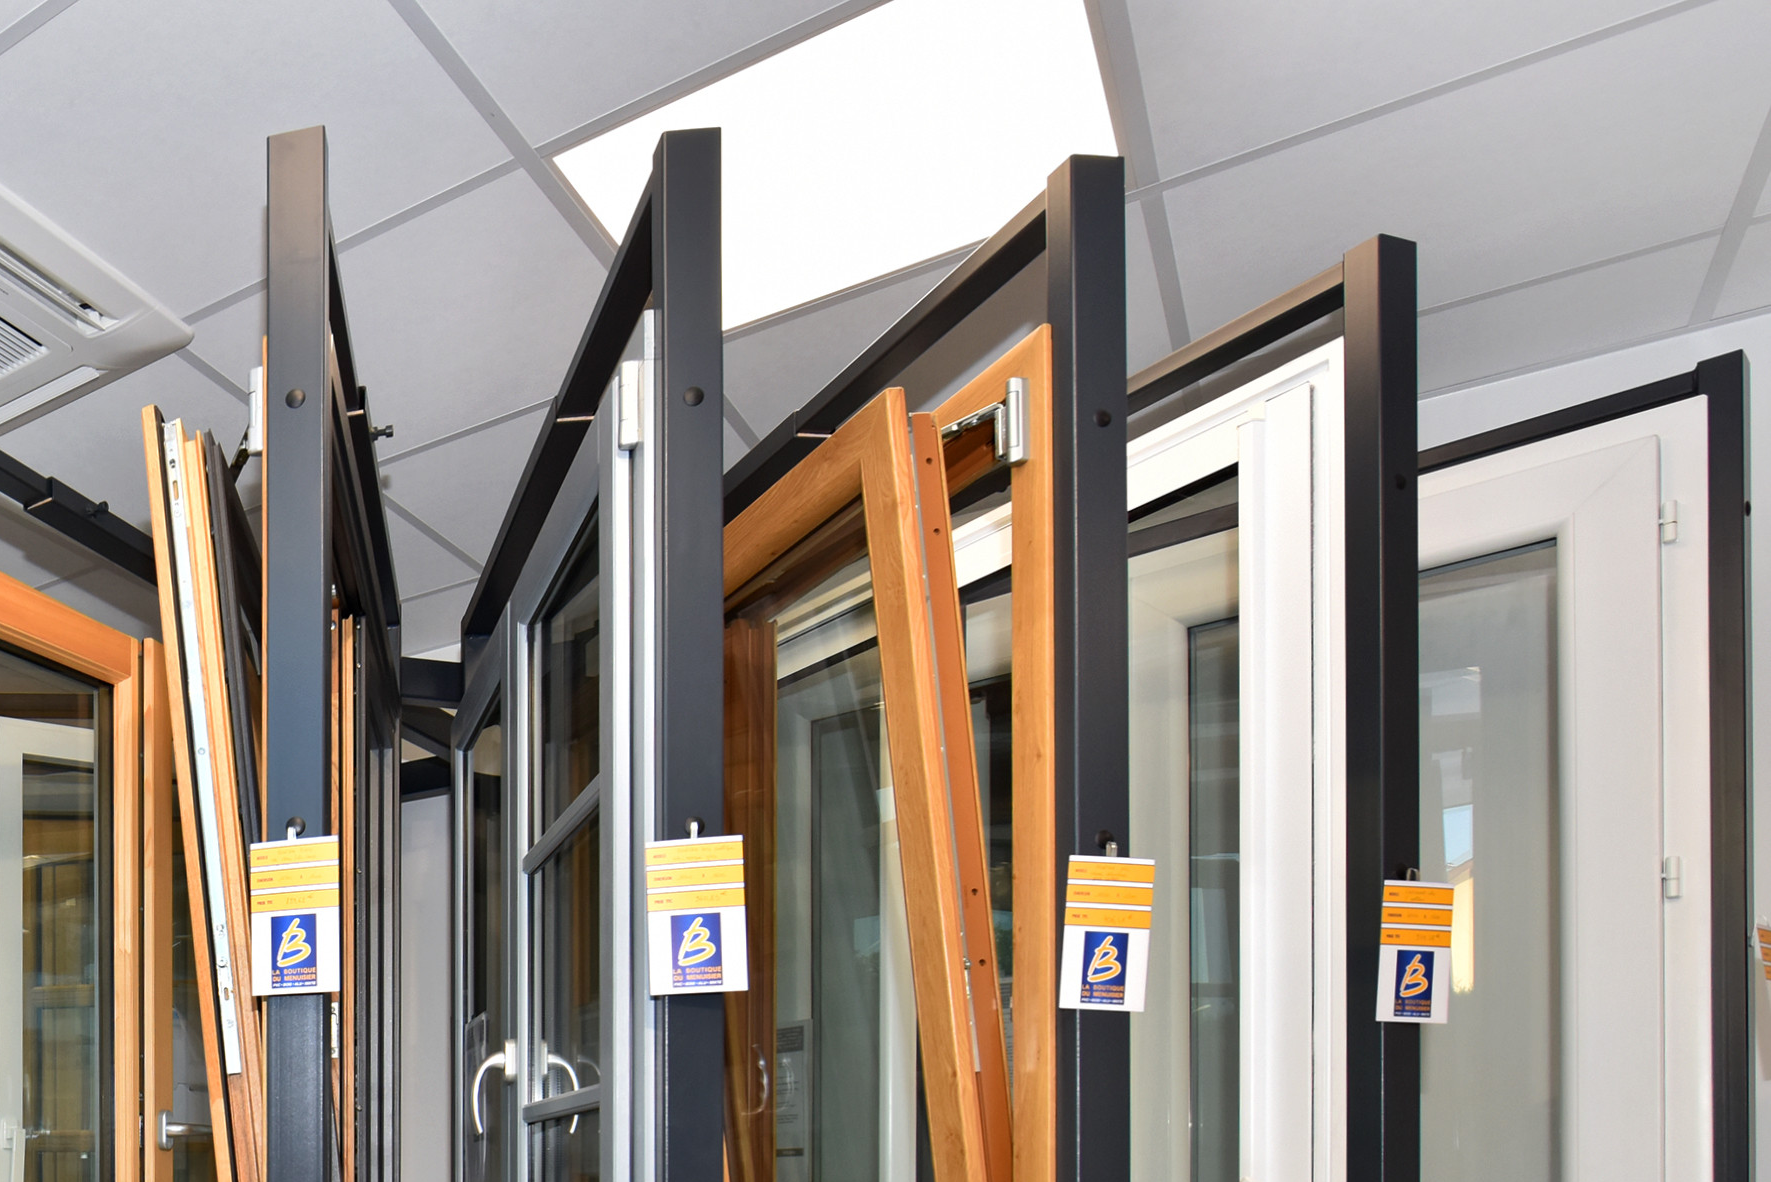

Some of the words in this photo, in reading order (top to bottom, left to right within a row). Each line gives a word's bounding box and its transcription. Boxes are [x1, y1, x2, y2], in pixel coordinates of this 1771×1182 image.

[276, 917, 312, 968] B
[678, 916, 717, 967] B
[283, 967, 317, 975] BOUTIQUE
[685, 966, 722, 974] BOUTIQUE
[1086, 935, 1122, 983] B
[284, 974, 317, 982] MENUISIER
[1093, 984, 1125, 992] BOUTIQUE
[1399, 953, 1429, 998] B
